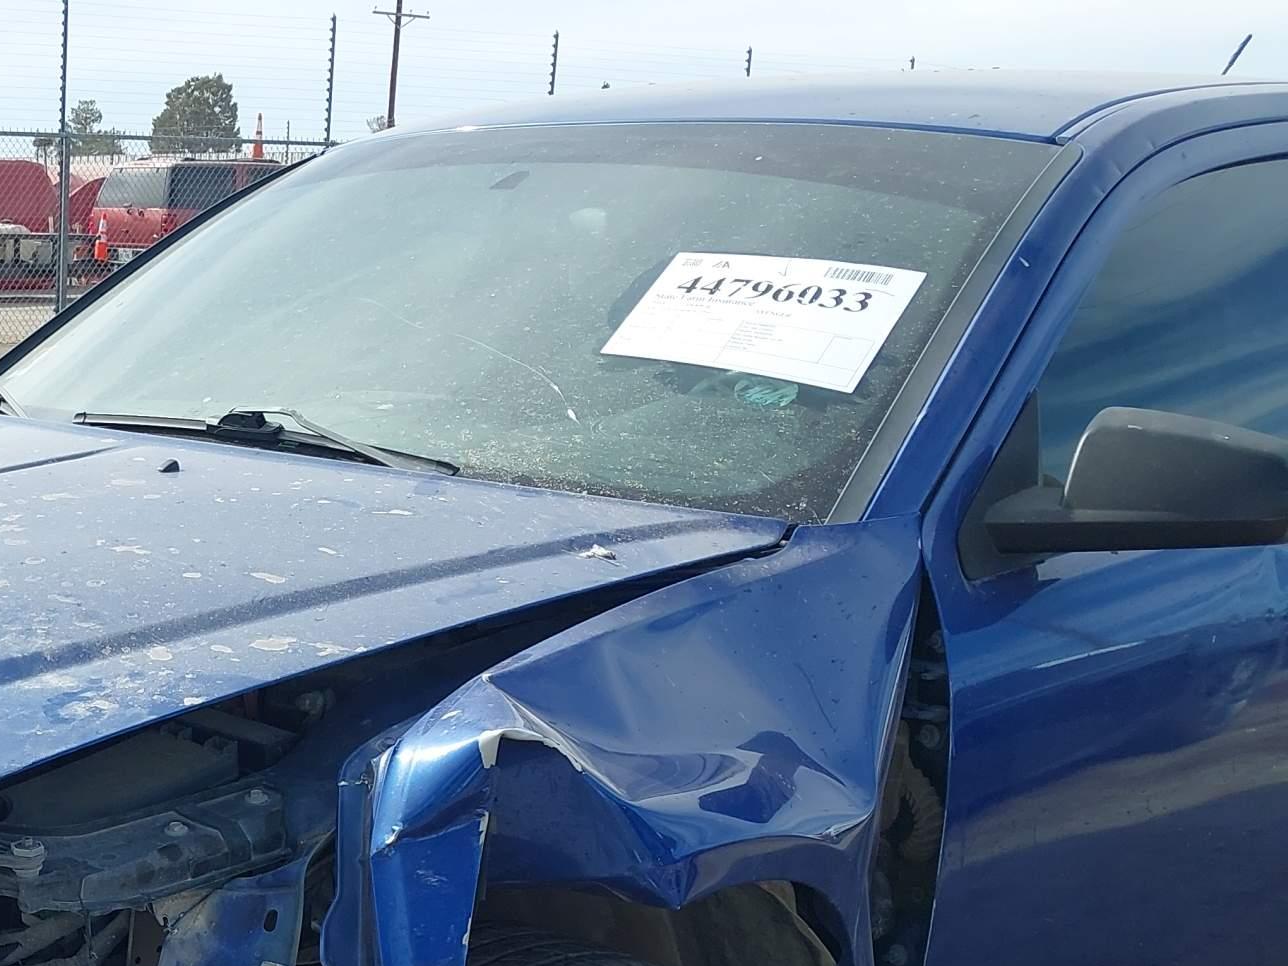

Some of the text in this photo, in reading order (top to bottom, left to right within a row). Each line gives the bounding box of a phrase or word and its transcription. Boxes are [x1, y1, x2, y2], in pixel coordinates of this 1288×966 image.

[676, 275, 873, 313] 44796033
[680, 294, 706, 303] Farm
[707, 296, 757, 307] Insurance
